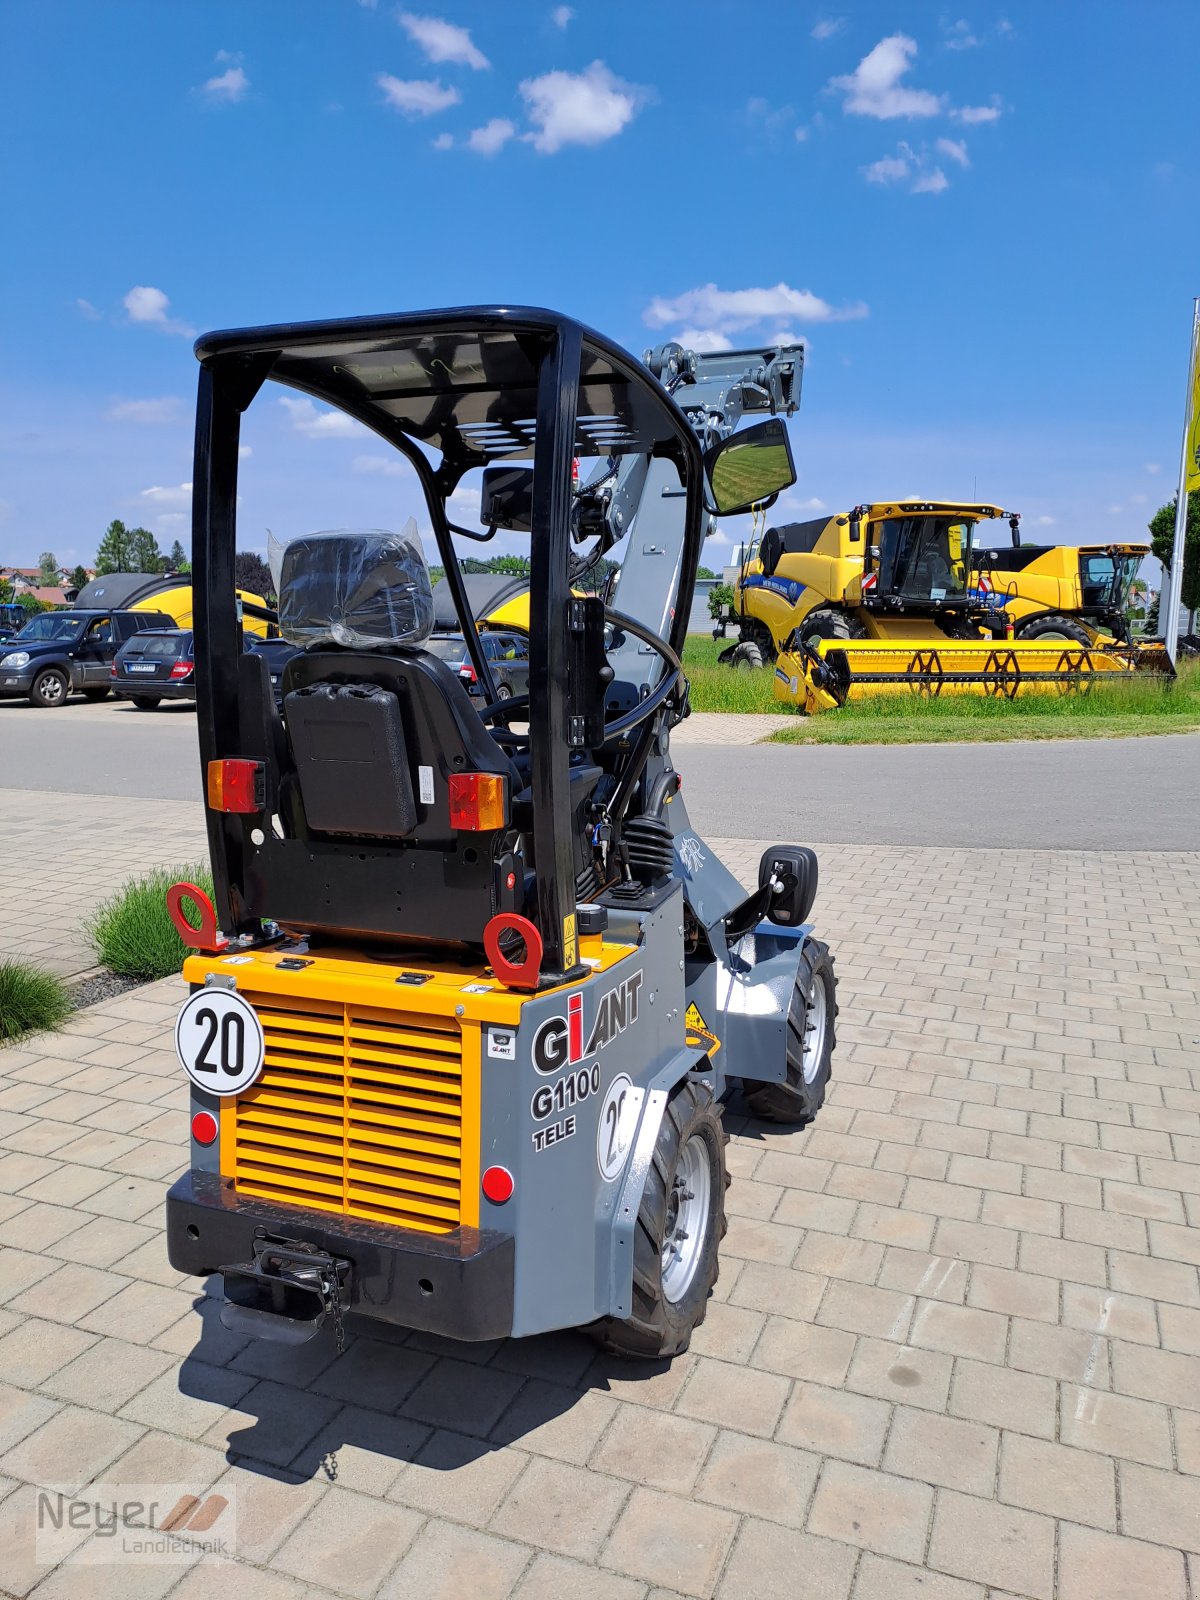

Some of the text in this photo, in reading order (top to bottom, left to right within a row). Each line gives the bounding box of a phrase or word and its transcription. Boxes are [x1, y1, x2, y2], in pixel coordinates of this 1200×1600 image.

[194, 1007, 245, 1077] 20
[531, 1062, 600, 1122] G1100
[532, 1115, 576, 1152] TELE
